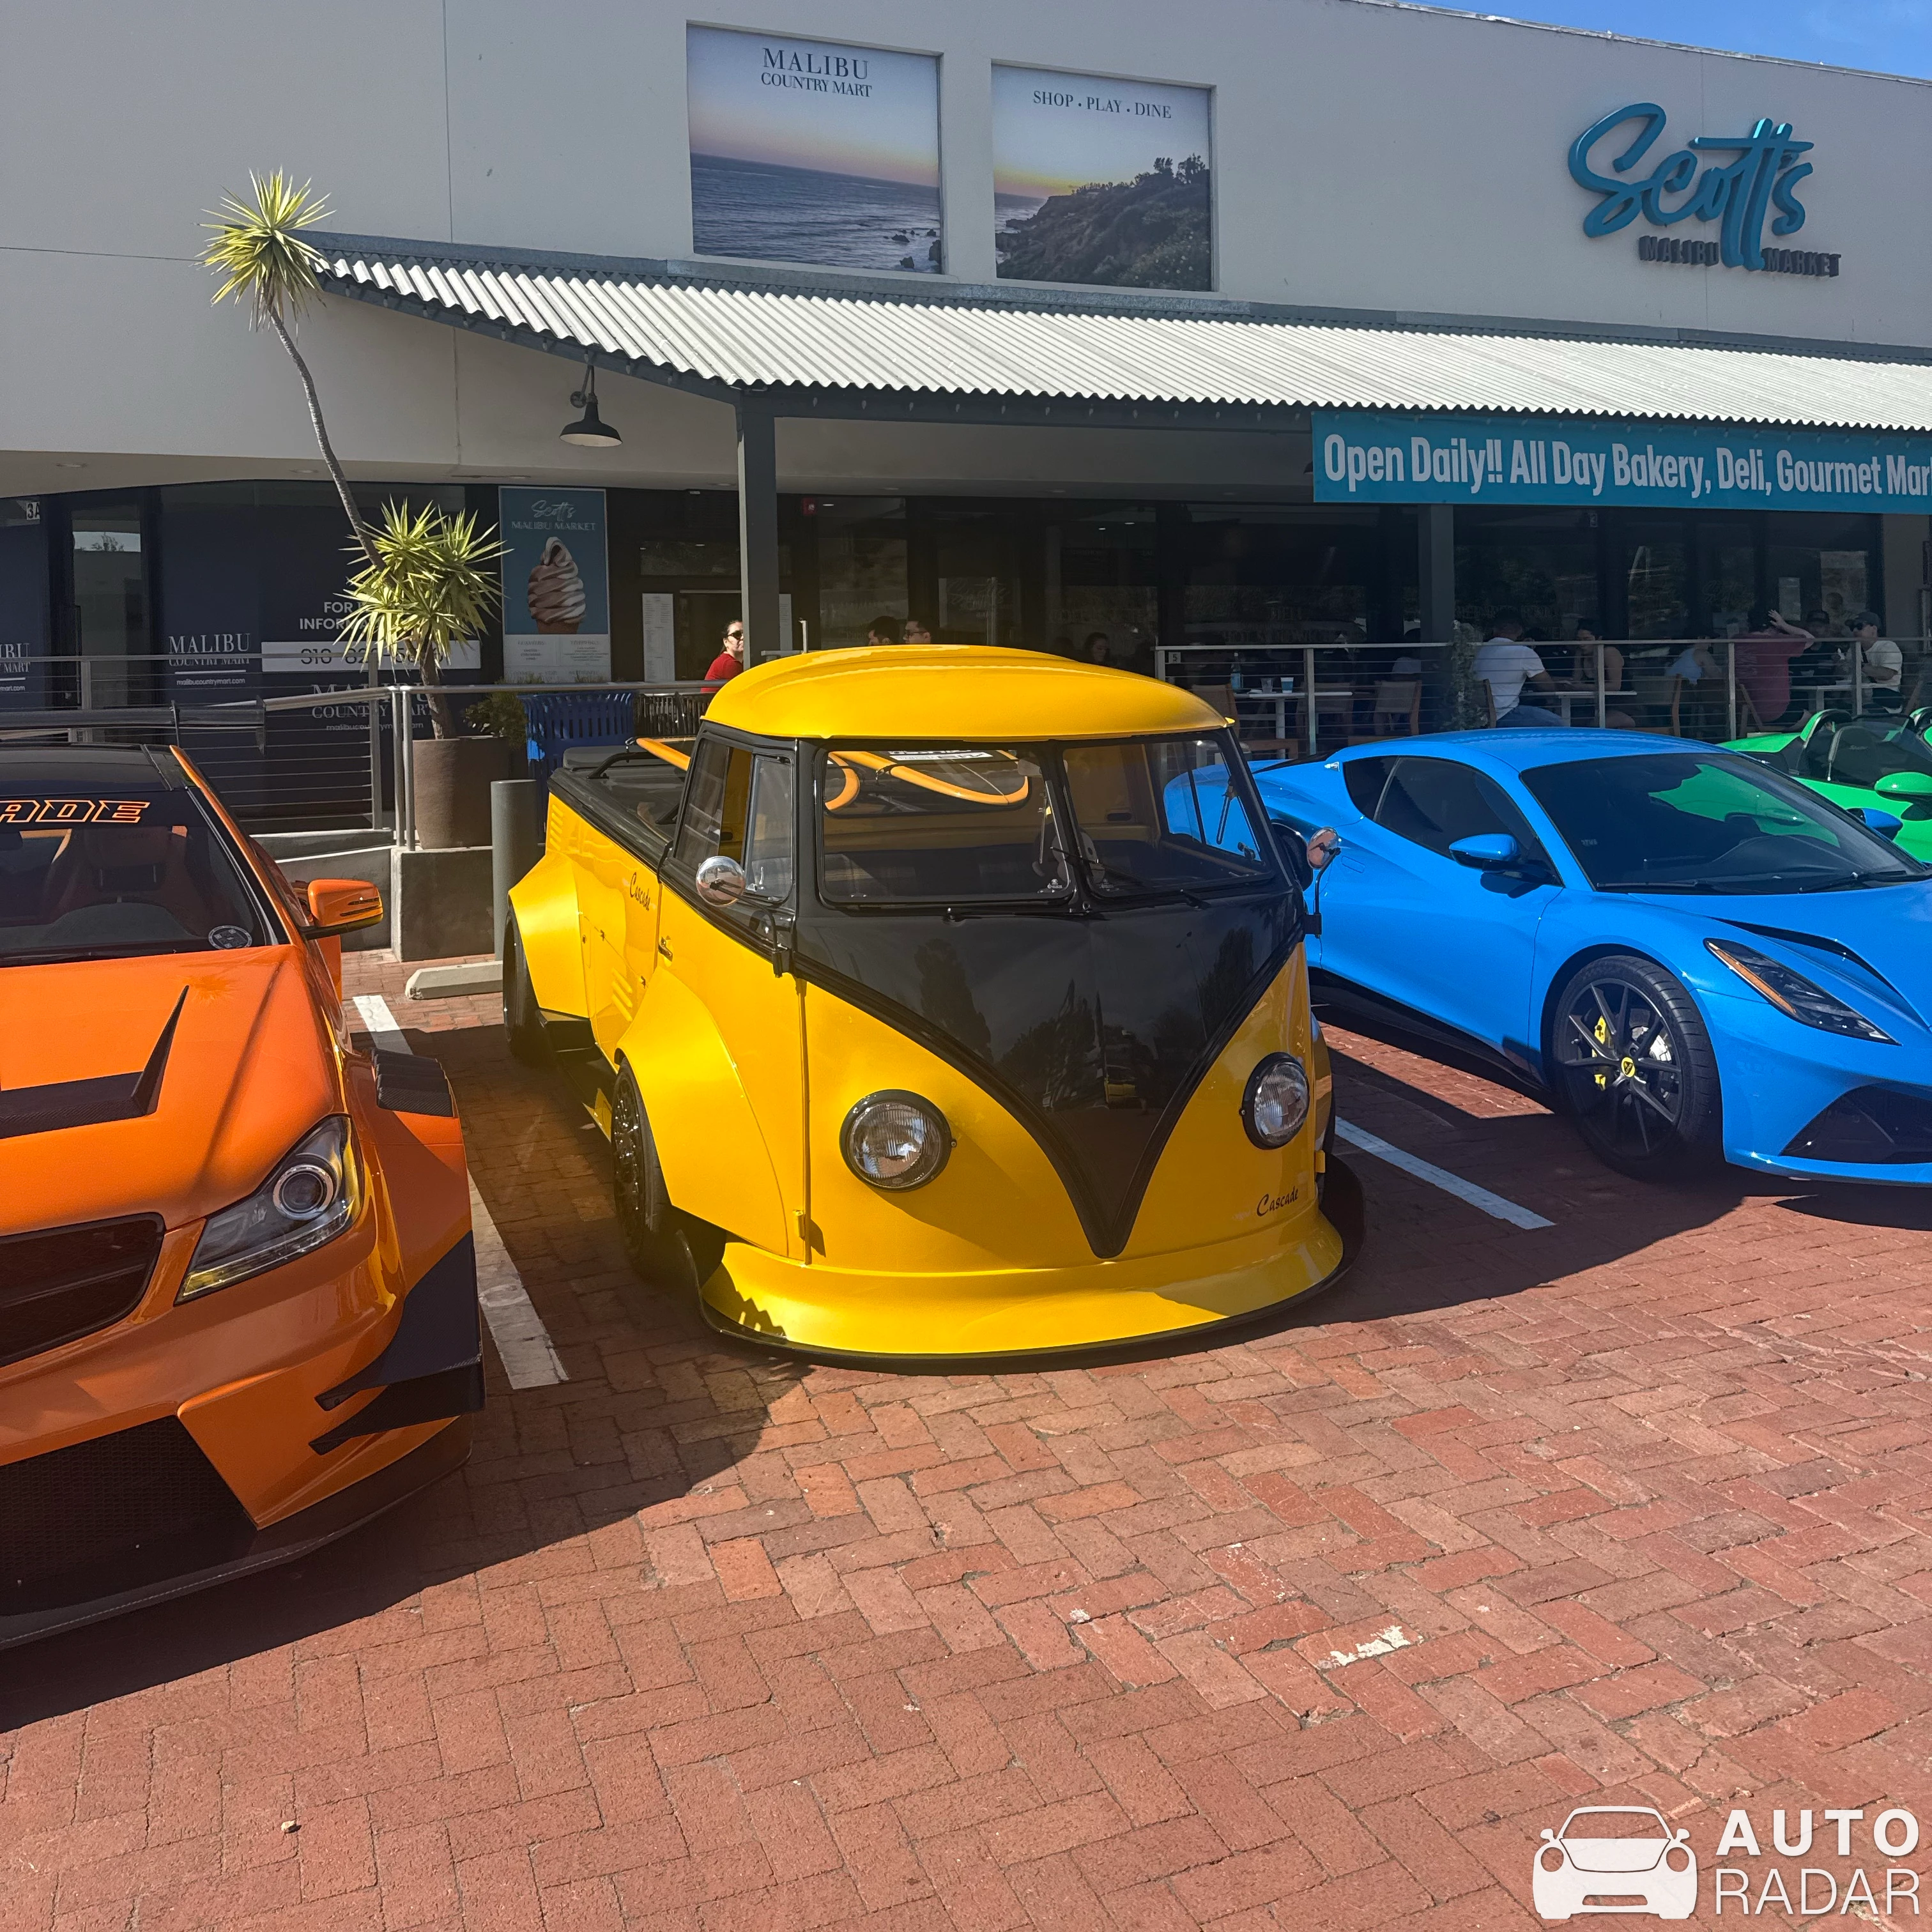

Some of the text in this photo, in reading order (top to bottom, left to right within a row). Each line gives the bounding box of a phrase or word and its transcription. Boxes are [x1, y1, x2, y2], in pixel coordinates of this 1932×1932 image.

[763, 48, 868, 79] MALIBU
[762, 72, 872, 97] COUNTRY MART
[1033, 90, 1172, 119] SHOP PLAY DINE
[1568, 102, 1814, 270] Scott's
[1639, 236, 1841, 277] MALIBU MARKET
[1324, 434, 1932, 498] Open Daily!! All Day Bakery, Deli, Gourmet Mar
[512, 521, 596, 531] MALIBU MARKET
[324, 602, 353, 613] FOR
[169, 633, 250, 654] MALIBU
[312, 705, 388, 719] COUNTY
[629, 871, 650, 912] Cascade
[1256, 1185, 1299, 1216] Cascade
